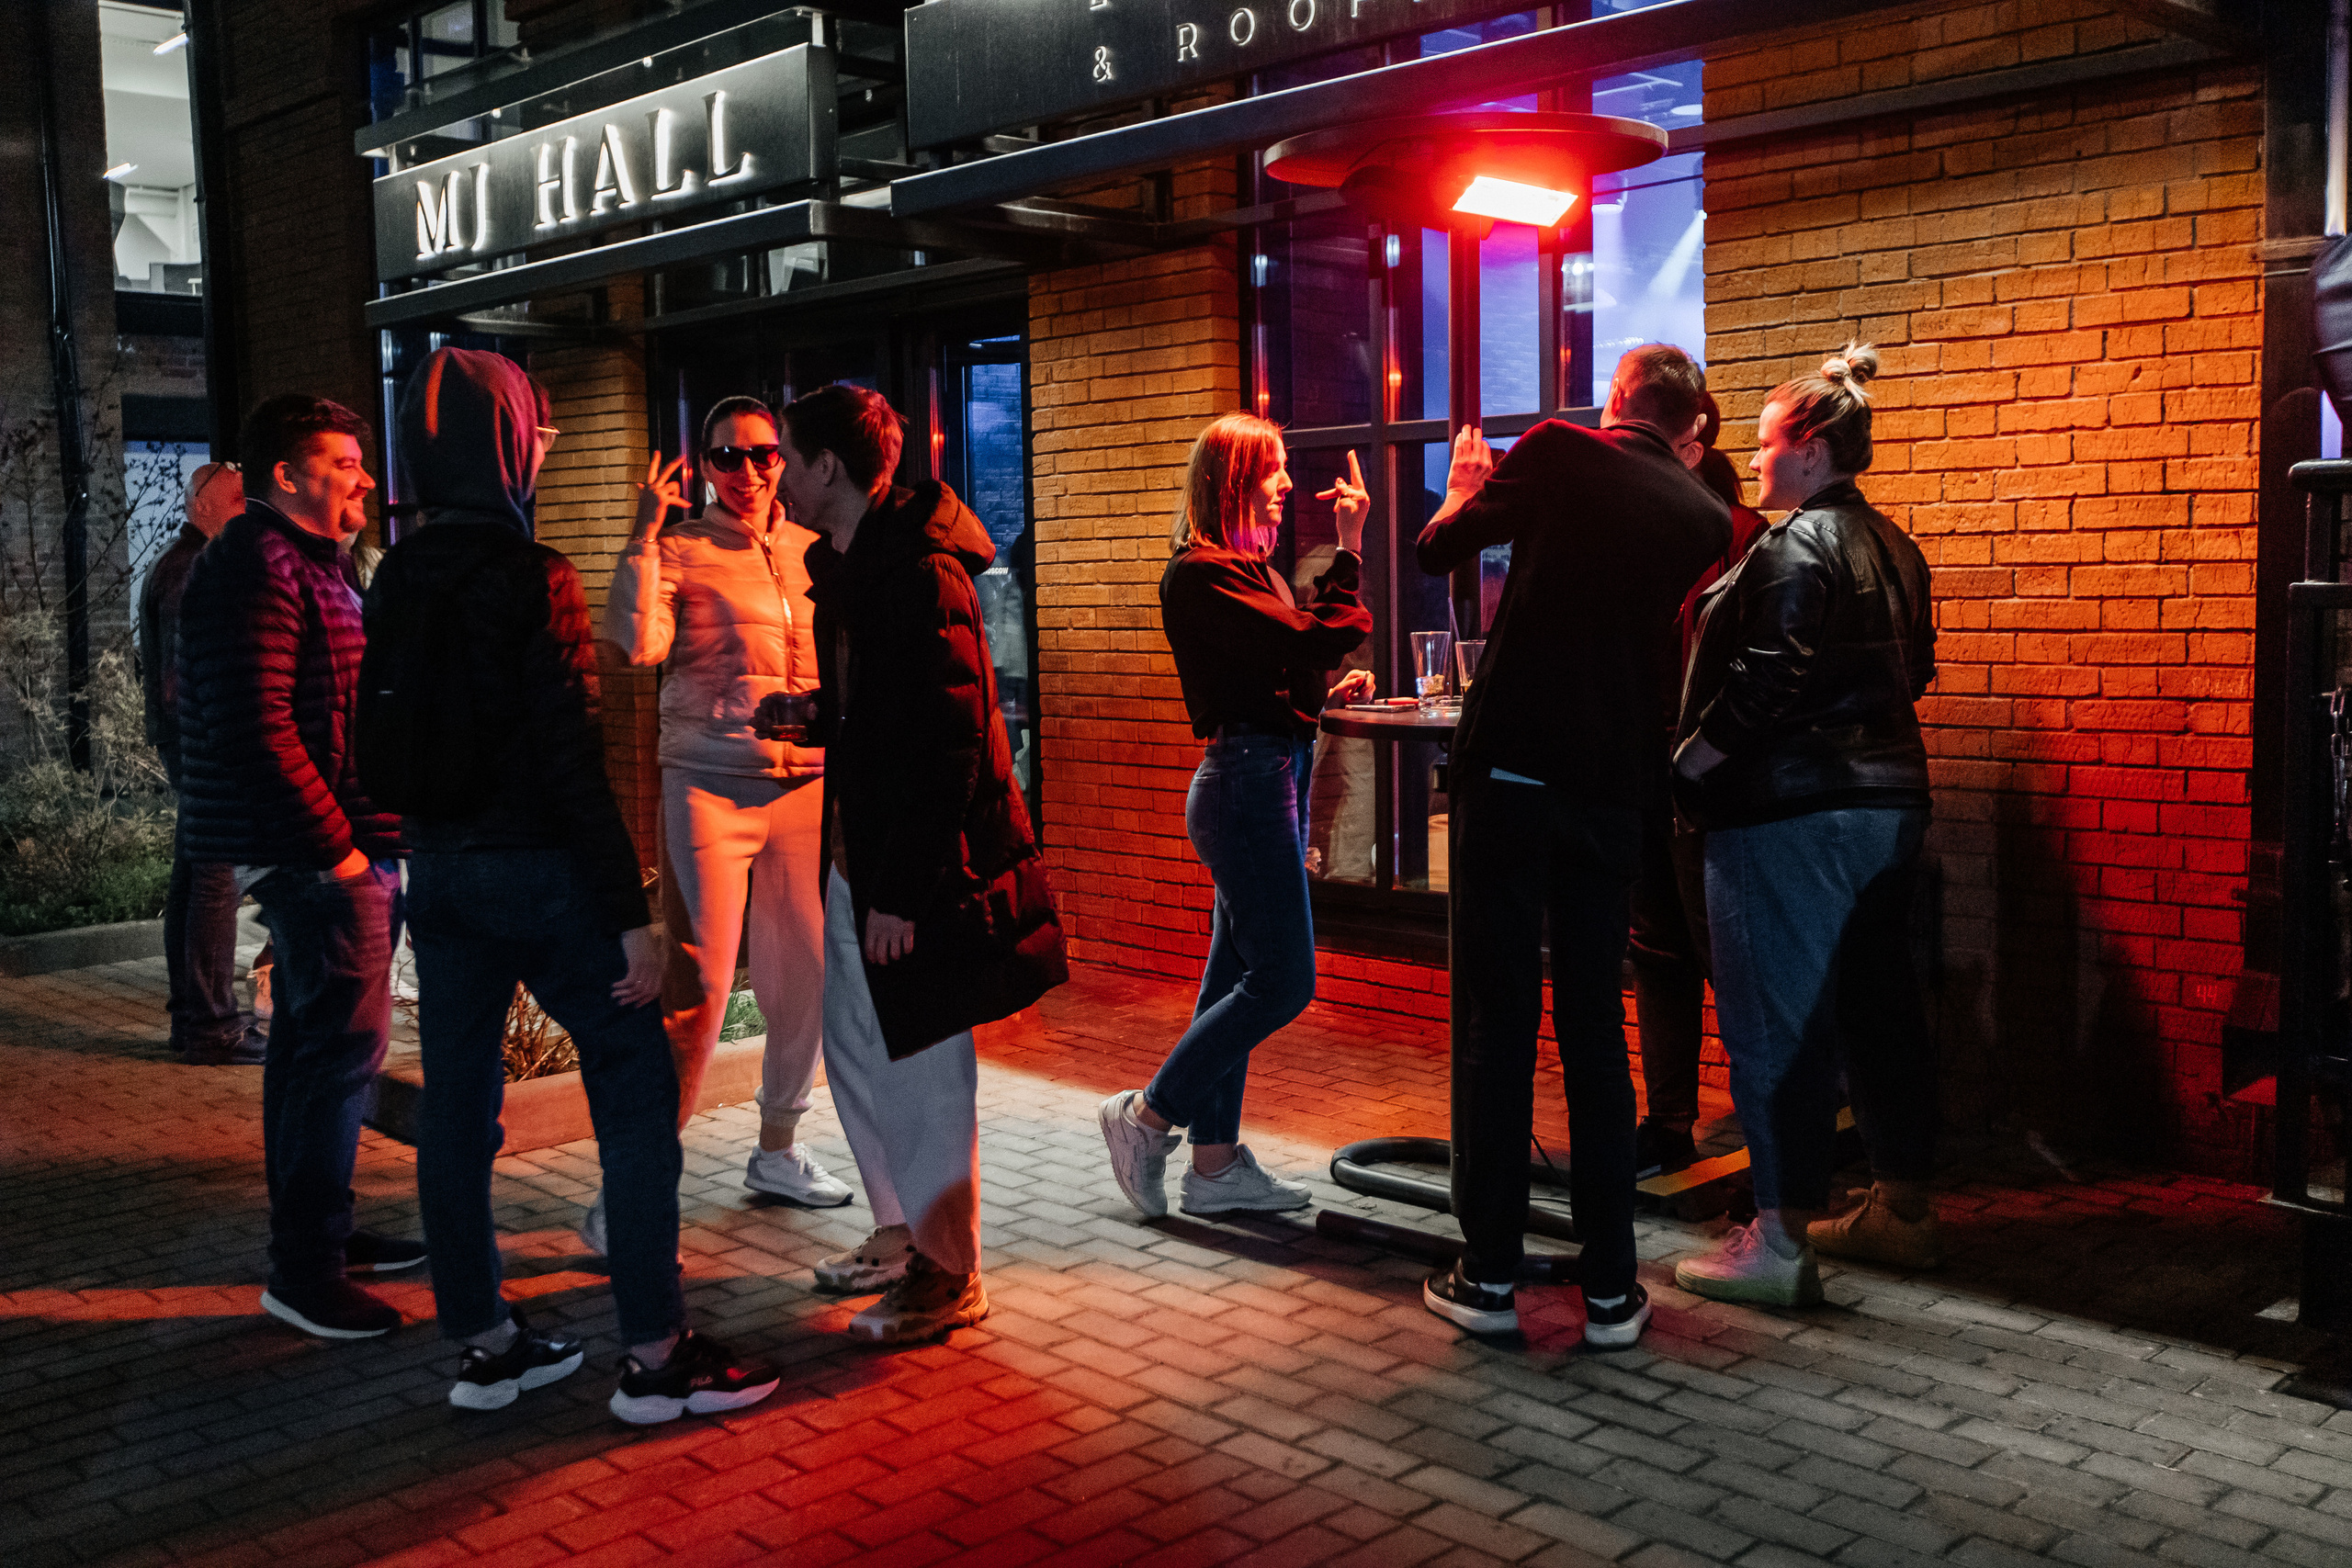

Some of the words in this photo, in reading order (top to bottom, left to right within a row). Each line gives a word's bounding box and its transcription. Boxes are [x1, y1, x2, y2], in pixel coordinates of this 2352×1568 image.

[1092, 46, 1114, 82] &
[415, 163, 490, 259] MJ
[530, 90, 755, 231] HALL
[984, 567, 1009, 575] OSCOW
